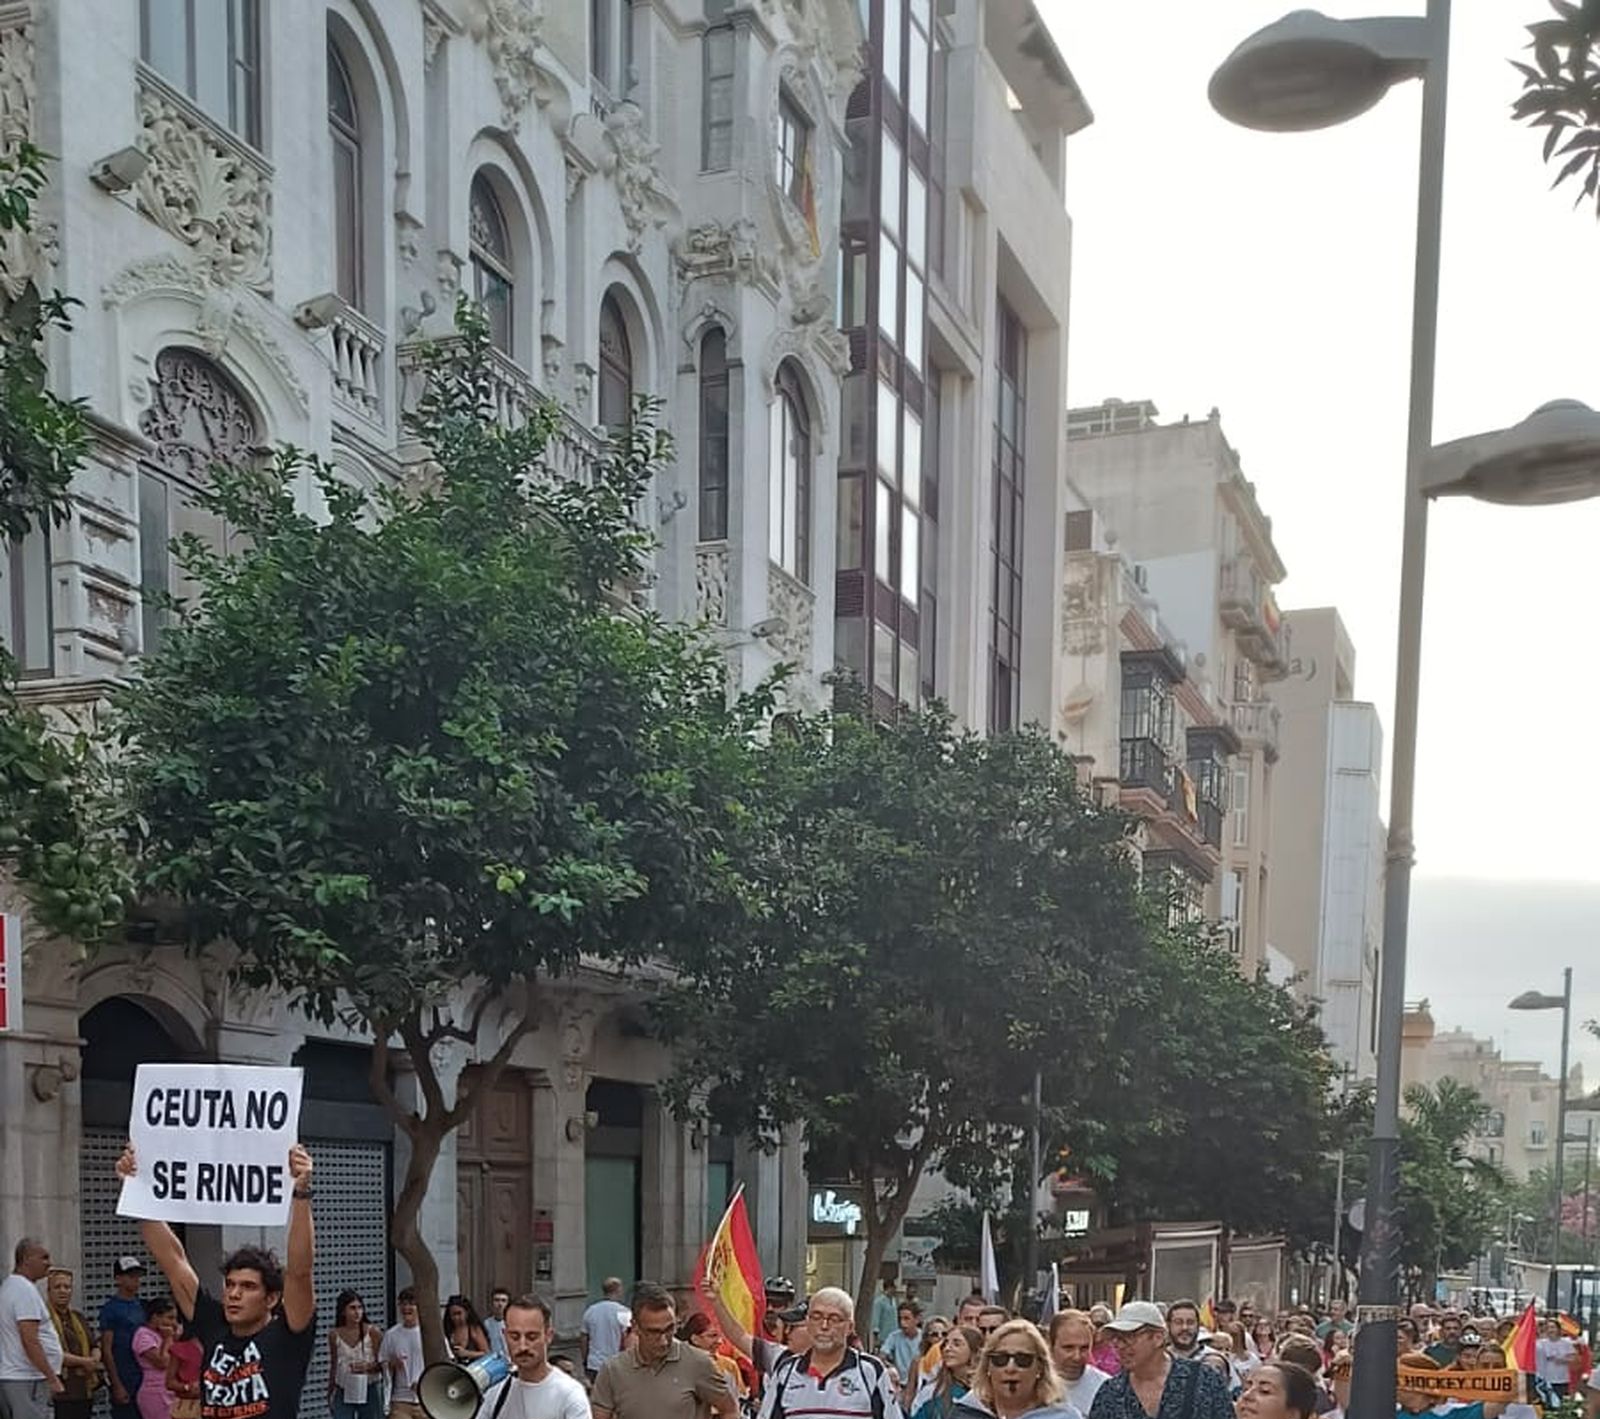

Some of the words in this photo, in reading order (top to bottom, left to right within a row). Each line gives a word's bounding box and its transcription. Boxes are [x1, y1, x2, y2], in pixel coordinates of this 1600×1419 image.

[146, 1088, 237, 1129] CEUTA
[245, 1090, 289, 1130] NO
[152, 1160, 188, 1200] SE
[196, 1162, 284, 1204] RINDE
[1404, 1374, 1466, 1390] HOCKEY
[1471, 1376, 1513, 1392] CLUB
